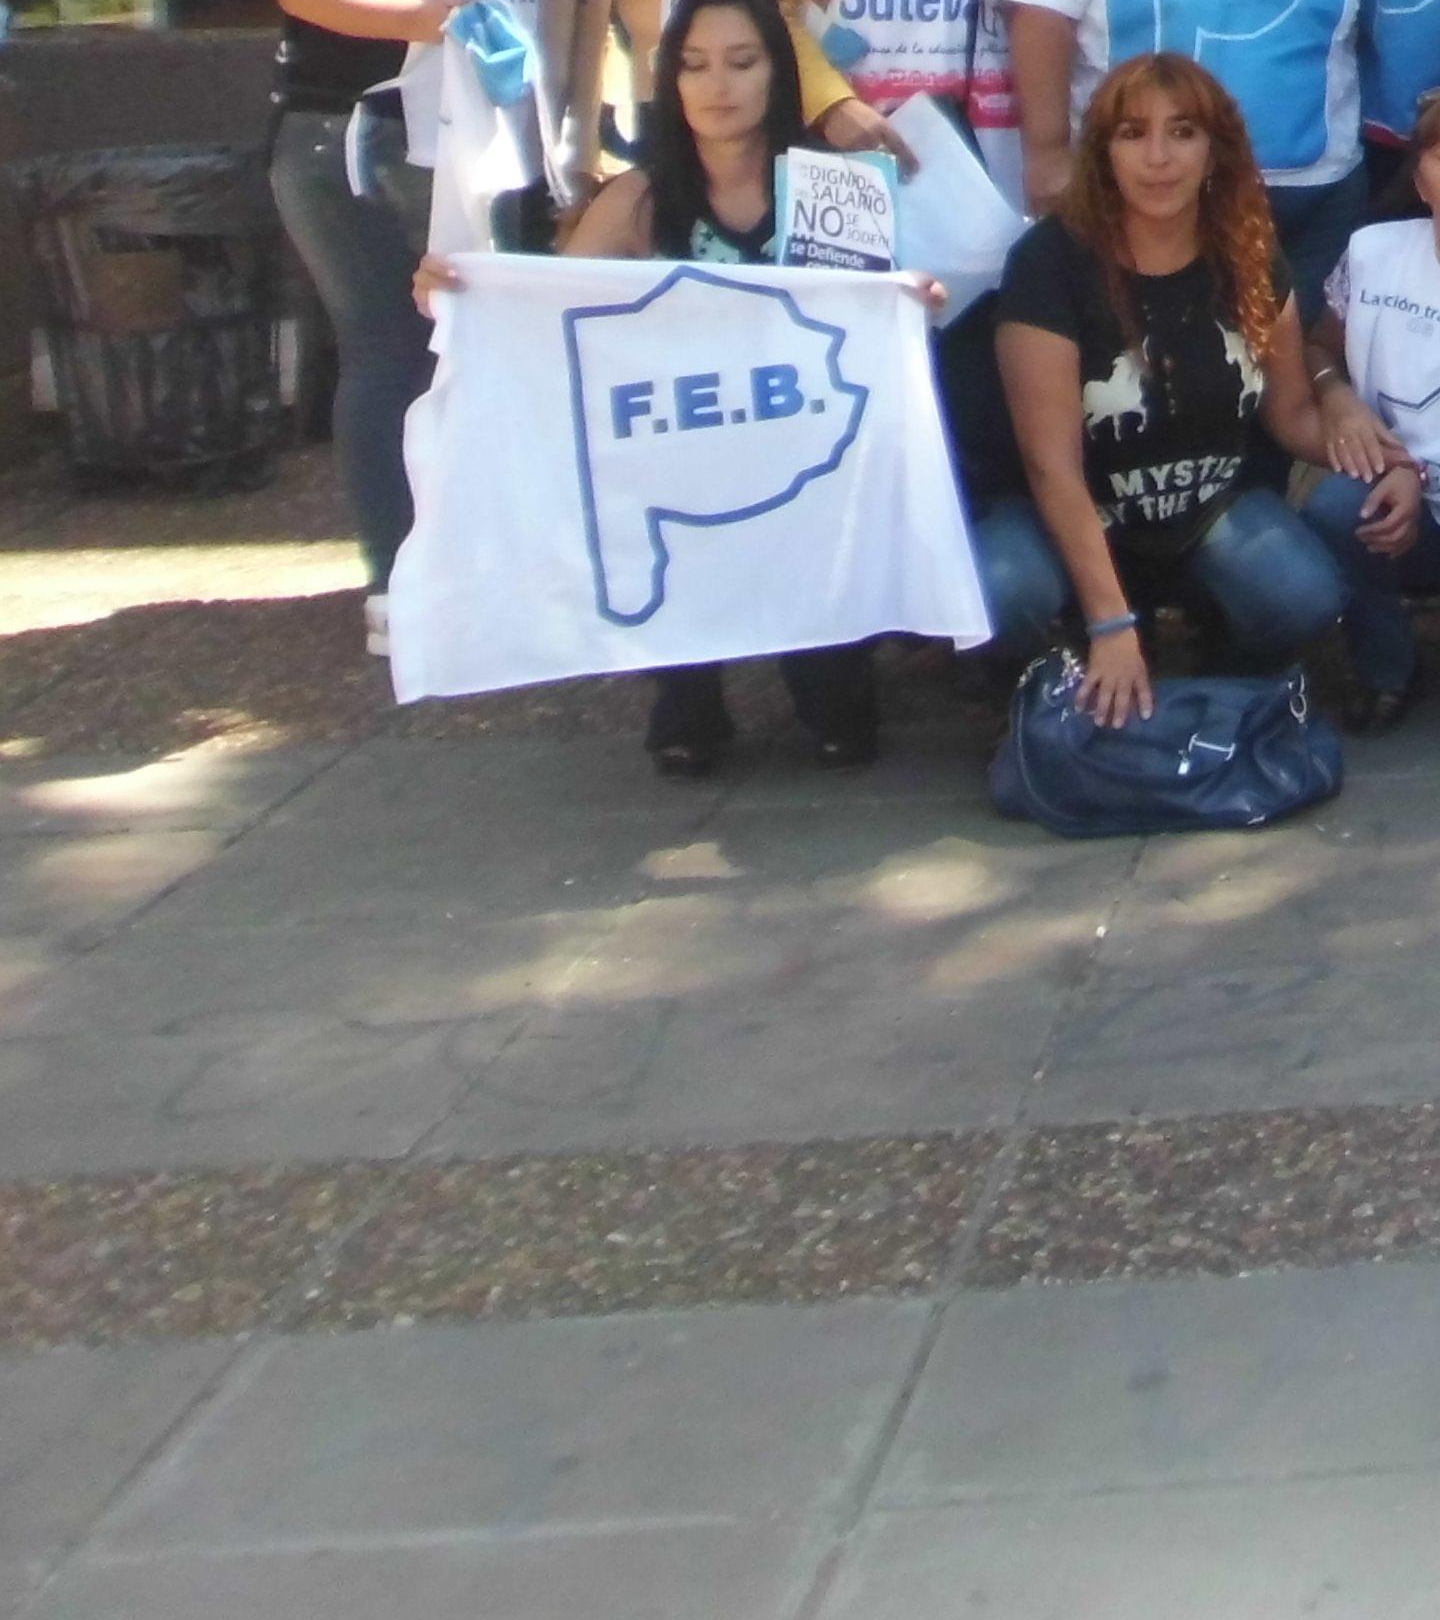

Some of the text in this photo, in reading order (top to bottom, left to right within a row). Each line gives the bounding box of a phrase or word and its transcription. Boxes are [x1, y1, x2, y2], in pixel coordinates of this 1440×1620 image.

[794, 199, 845, 239] NO
[1360, 289, 1380, 307] La
[610, 362, 827, 440] F.E.B.
[1109, 455, 1242, 499] MYSTIC
[1138, 490, 1194, 522] THE
